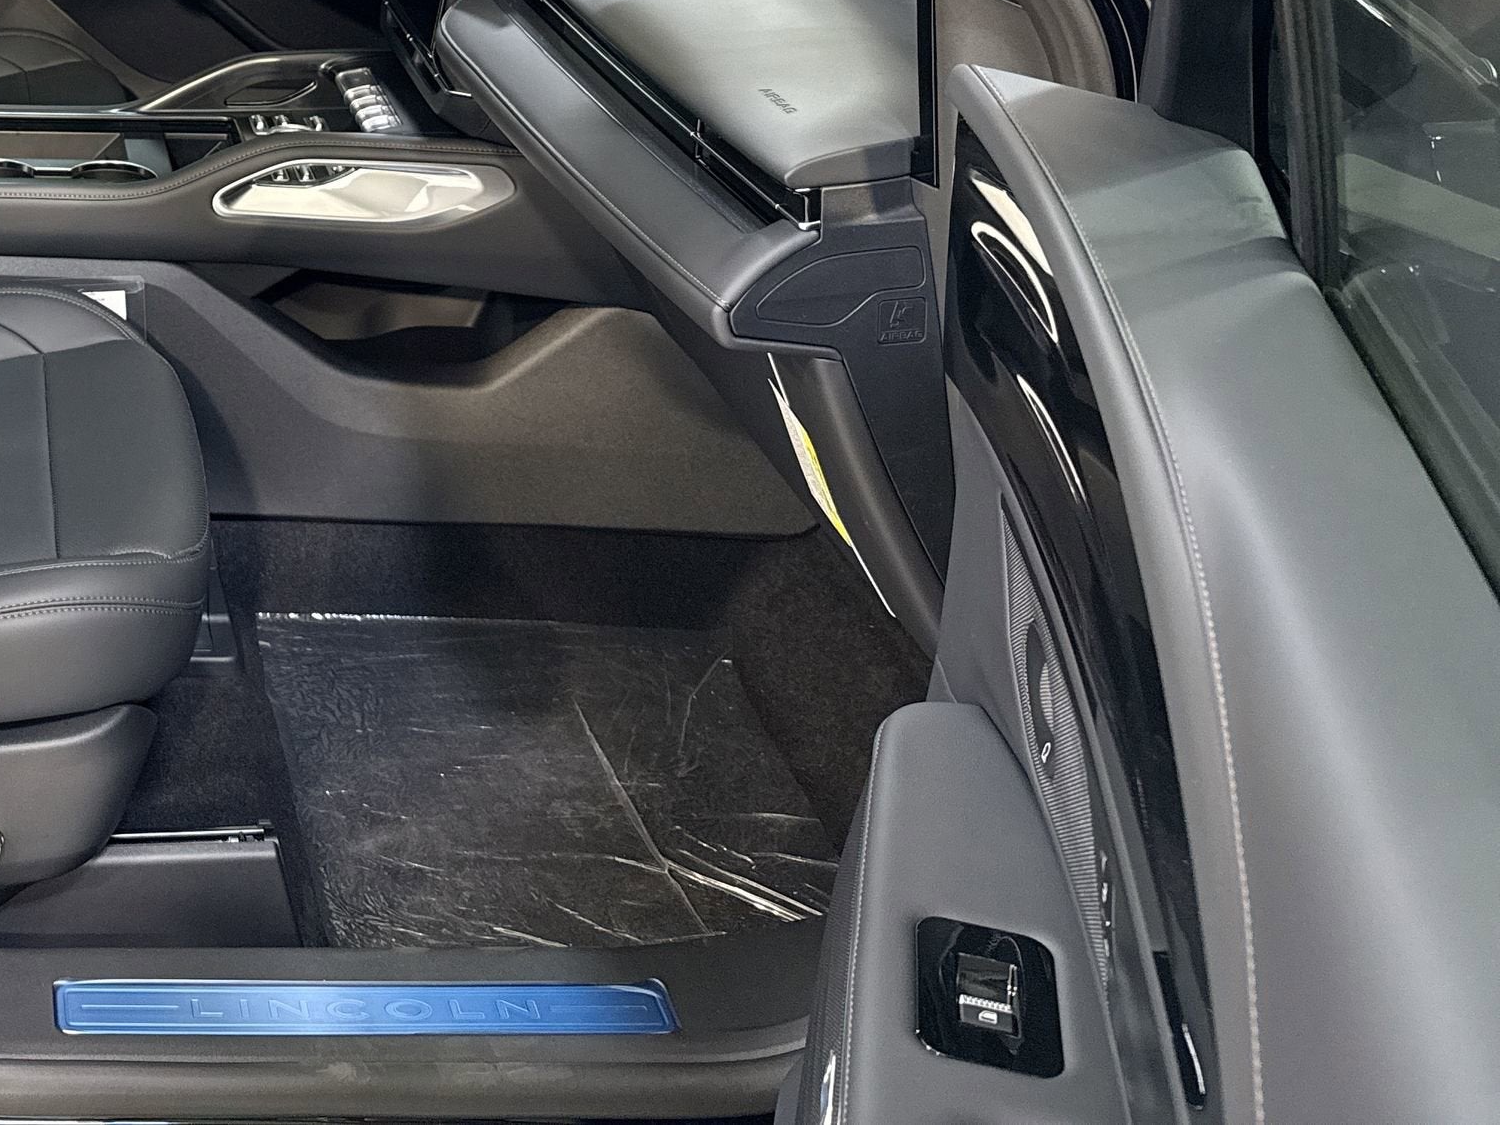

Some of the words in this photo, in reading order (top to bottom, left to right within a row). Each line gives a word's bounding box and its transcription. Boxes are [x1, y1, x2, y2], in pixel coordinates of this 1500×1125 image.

[757, 88, 798, 115] AIRBAG
[879, 331, 923, 342] AIRBAG
[188, 996, 541, 1022] LINCOLN
